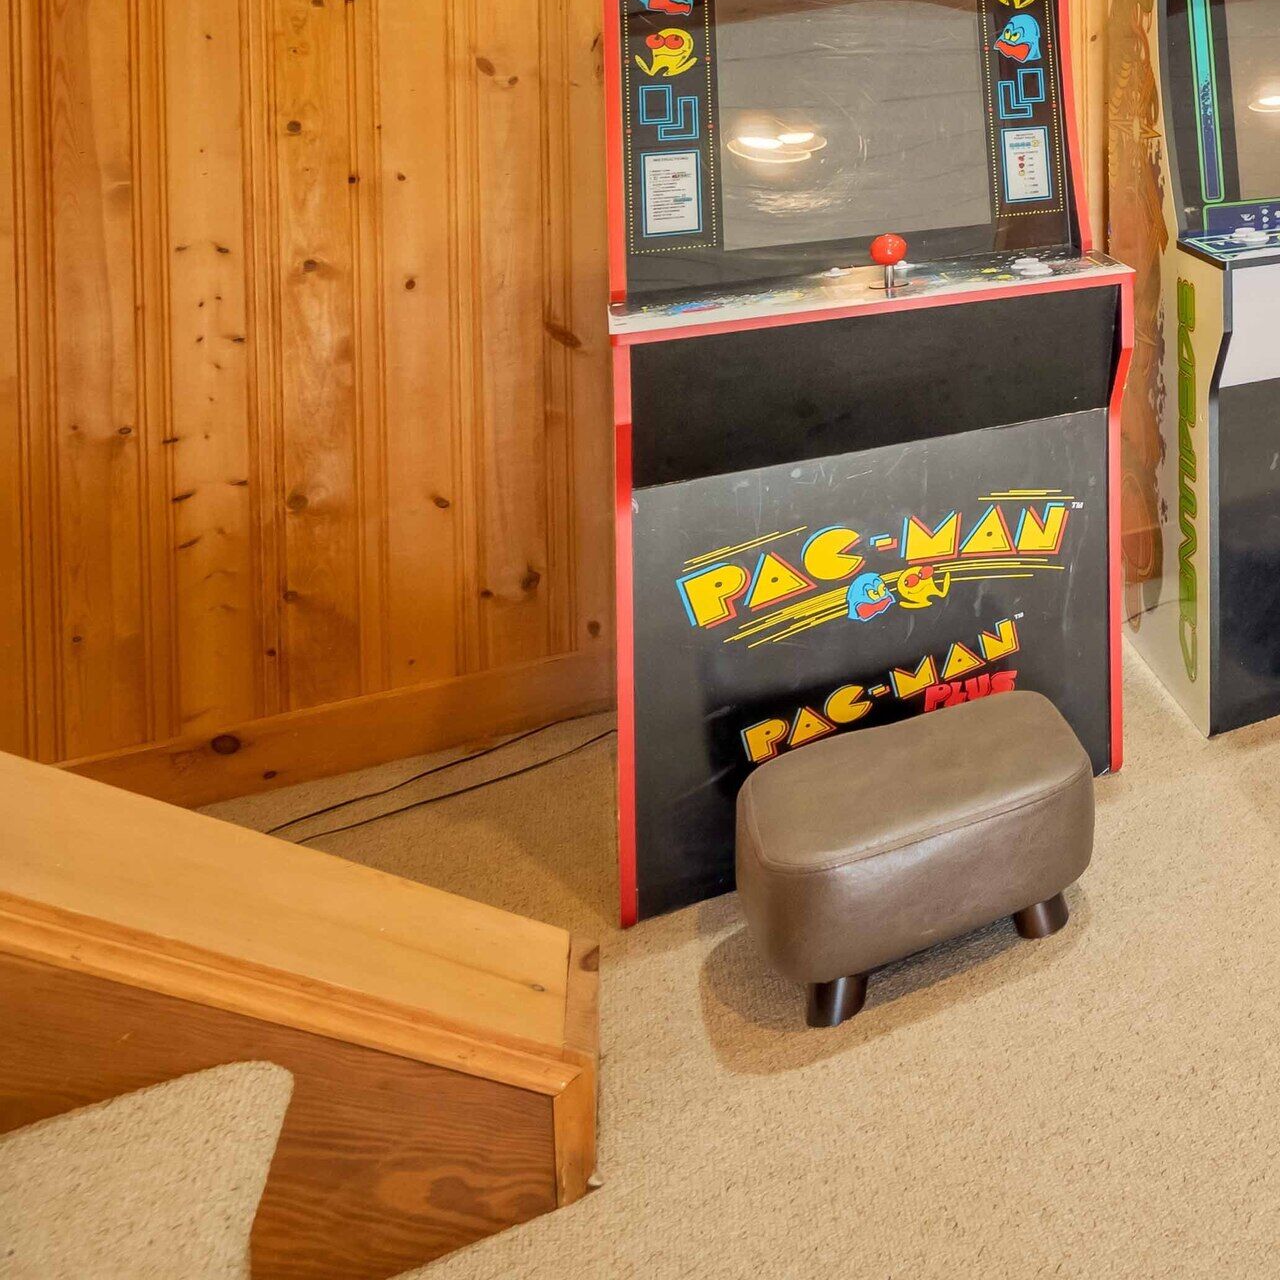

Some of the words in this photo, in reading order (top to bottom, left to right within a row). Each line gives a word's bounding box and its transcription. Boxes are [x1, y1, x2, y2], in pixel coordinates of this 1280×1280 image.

[675, 502, 1069, 629] PAC-MAN
[740, 618, 1020, 763] PAC-MAN
[924, 670, 1017, 713] PLUS
